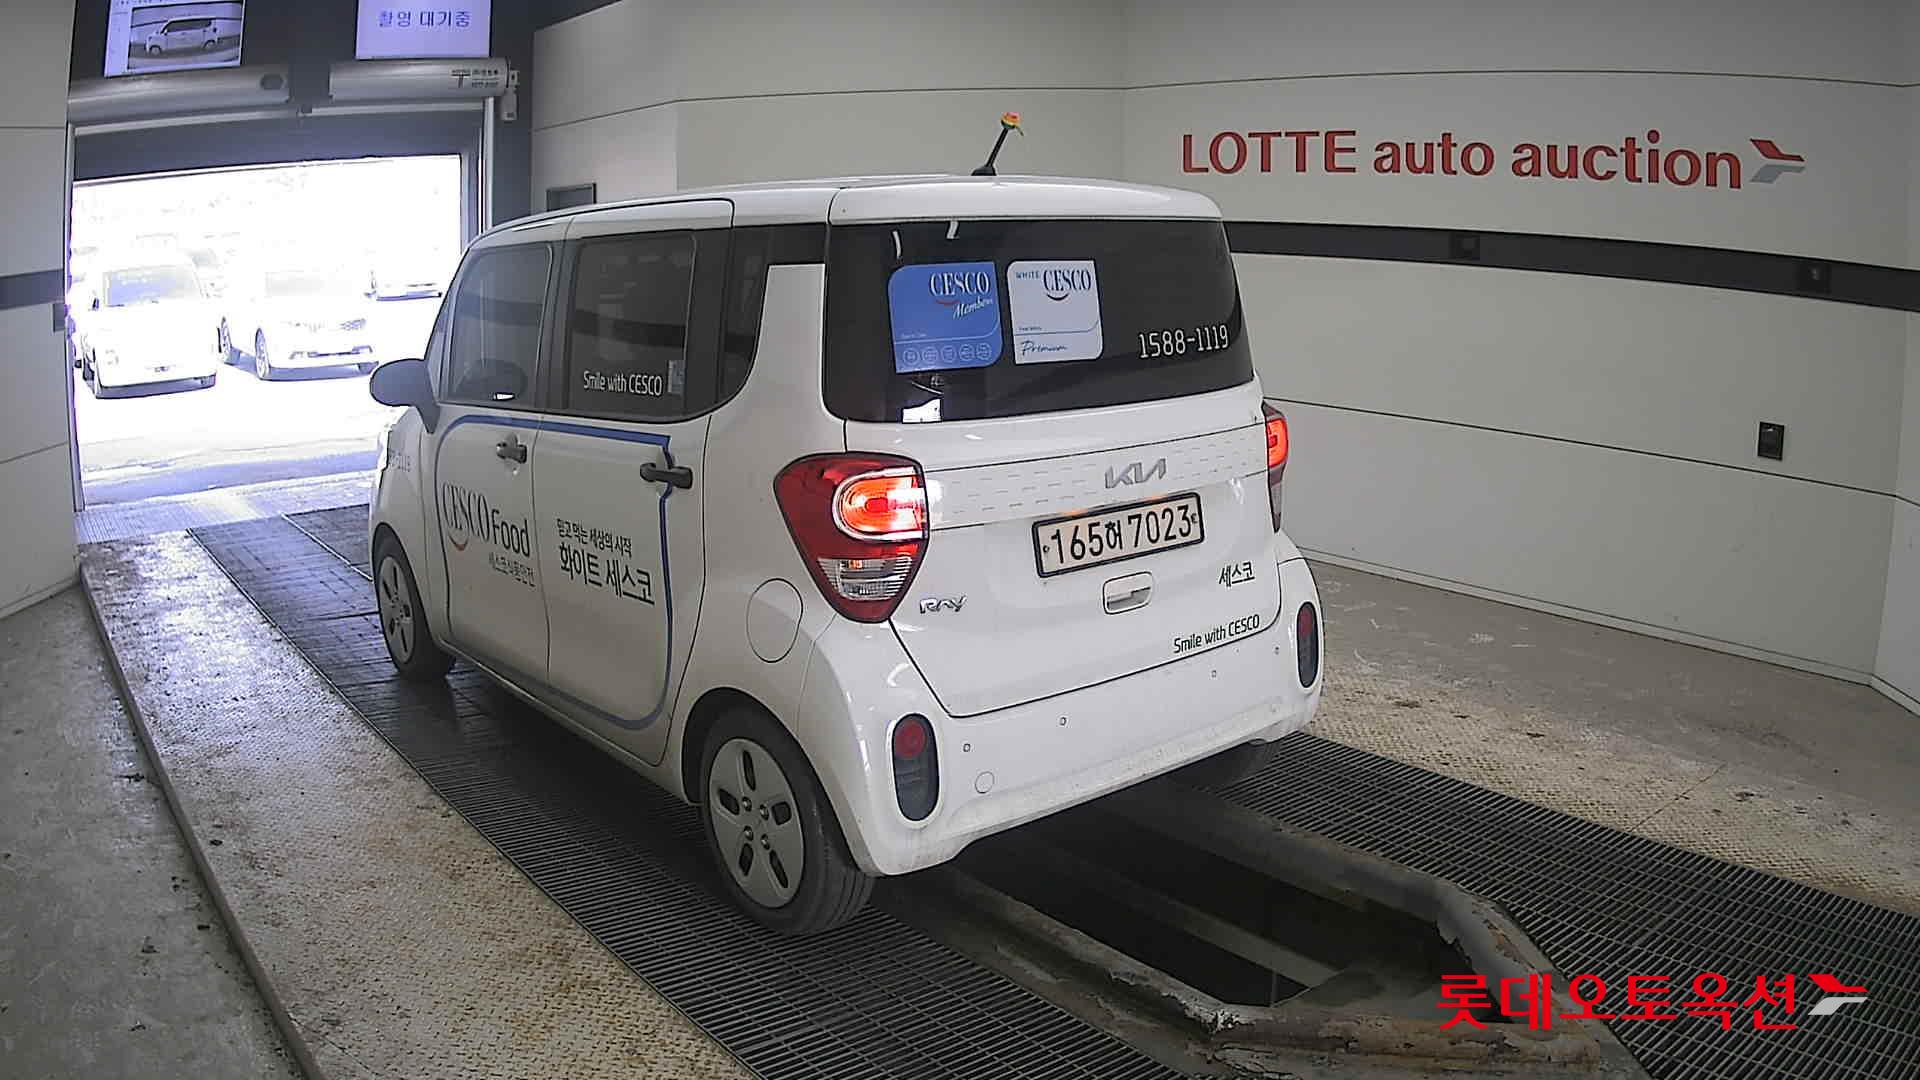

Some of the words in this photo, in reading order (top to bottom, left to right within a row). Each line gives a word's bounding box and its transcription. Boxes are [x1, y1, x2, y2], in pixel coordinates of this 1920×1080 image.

[420, 11, 471, 28] 대기중
[1182, 130, 1357, 174] LOTTE
[1373, 131, 1495, 177] auto
[1511, 129, 1742, 190] auction
[929, 271, 991, 297] CESCO
[1043, 269, 1092, 292] CESCO
[1138, 324, 1229, 359] 1588-1119
[583, 370, 606, 391] Smile
[607, 373, 627, 393] with
[628, 374, 663, 396] CESCO
[442, 482, 490, 542] CESCO
[491, 507, 531, 558] Food
[1051, 519, 1124, 565] 165허
[1127, 504, 1191, 549] 7023
[572, 522, 588, 545] 먹는
[589, 528, 614, 553] 세상의
[614, 535, 632, 558] 시작
[559, 542, 603, 587] 화이트
[606, 558, 656, 606] 세스코
[1218, 561, 1256, 588] 세스코
[918, 594, 967, 614] RAY
[1173, 633, 1202, 654] Smile
[1204, 625, 1226, 644] with
[1228, 613, 1260, 637] CESCO
